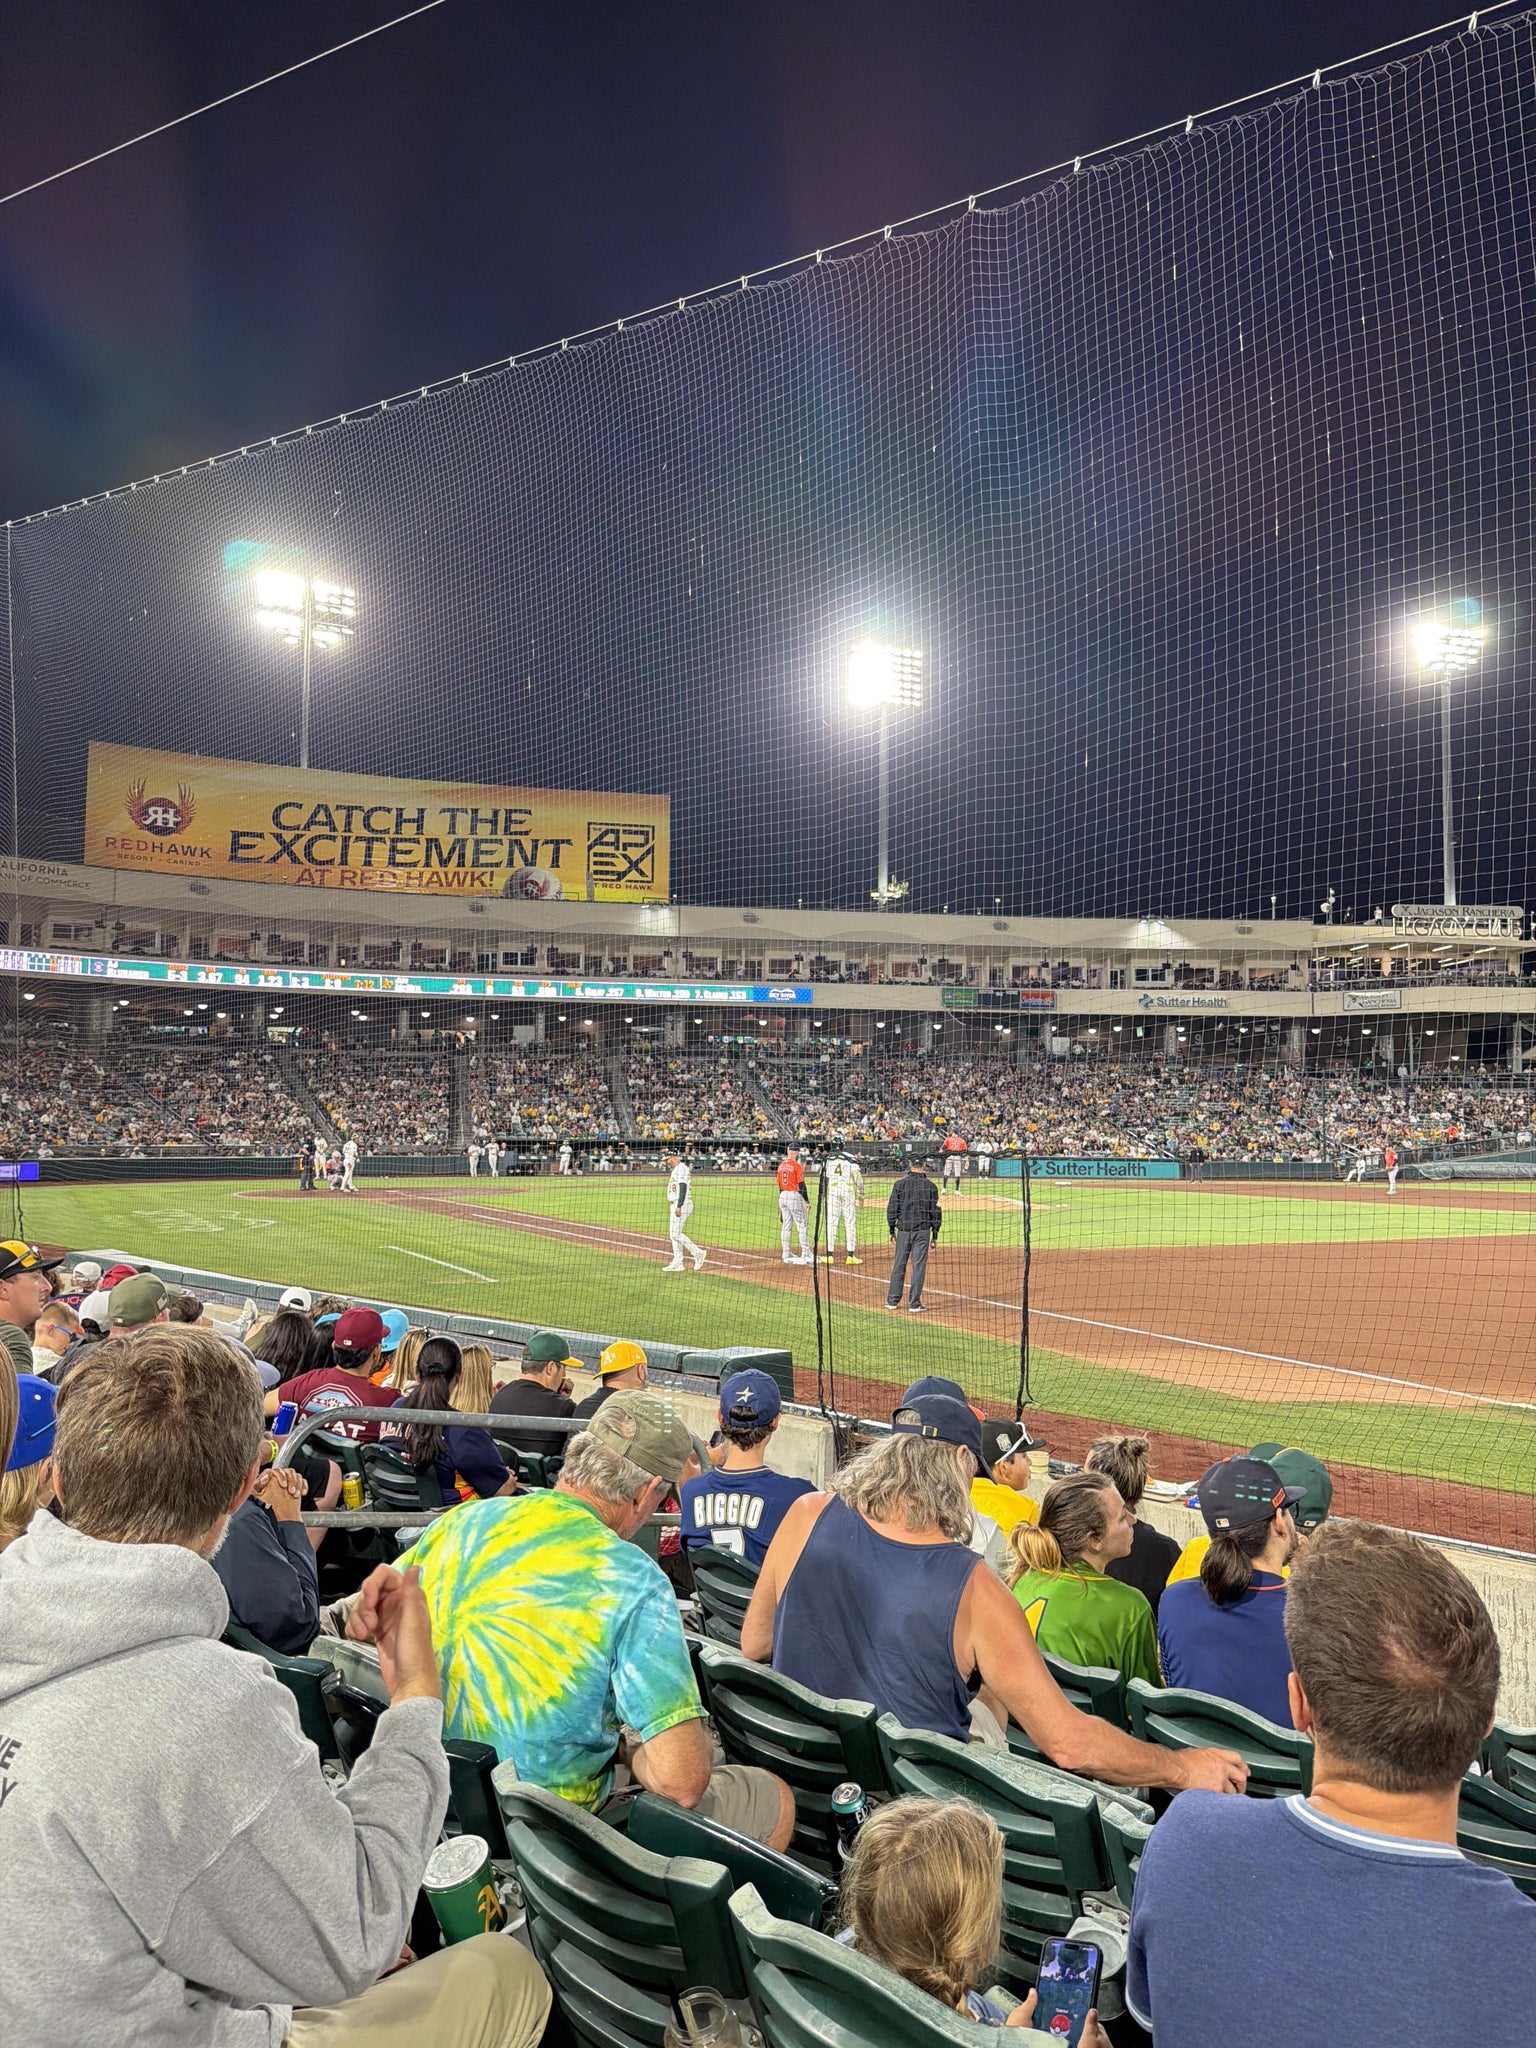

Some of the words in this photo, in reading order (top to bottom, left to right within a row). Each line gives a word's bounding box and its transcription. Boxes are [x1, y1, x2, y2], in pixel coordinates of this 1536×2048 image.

[271, 801, 427, 836] CATCH
[439, 807, 533, 836] THE
[105, 836, 212, 859] REDHAWK
[228, 830, 574, 869] EXCITEMENT
[0, 860, 68, 876] ALIFORNIA
[296, 868, 333, 886] AT
[338, 869, 398, 889] RED
[405, 870, 495, 888] HAWK!
[1392, 917, 1469, 937] LEGACY
[1472, 917, 1523, 938] CLUB
[1156, 997, 1190, 1007] Sutter
[1192, 997, 1228, 1008] Health
[1194, 1034, 1202, 1046] 9
[782, 1171, 789, 1185] 8
[834, 1163, 843, 1177] 4
[1046, 1163, 1095, 1176] Sutter
[1096, 1163, 1146, 1176] Health
[693, 1492, 765, 1529] BIGGIO
